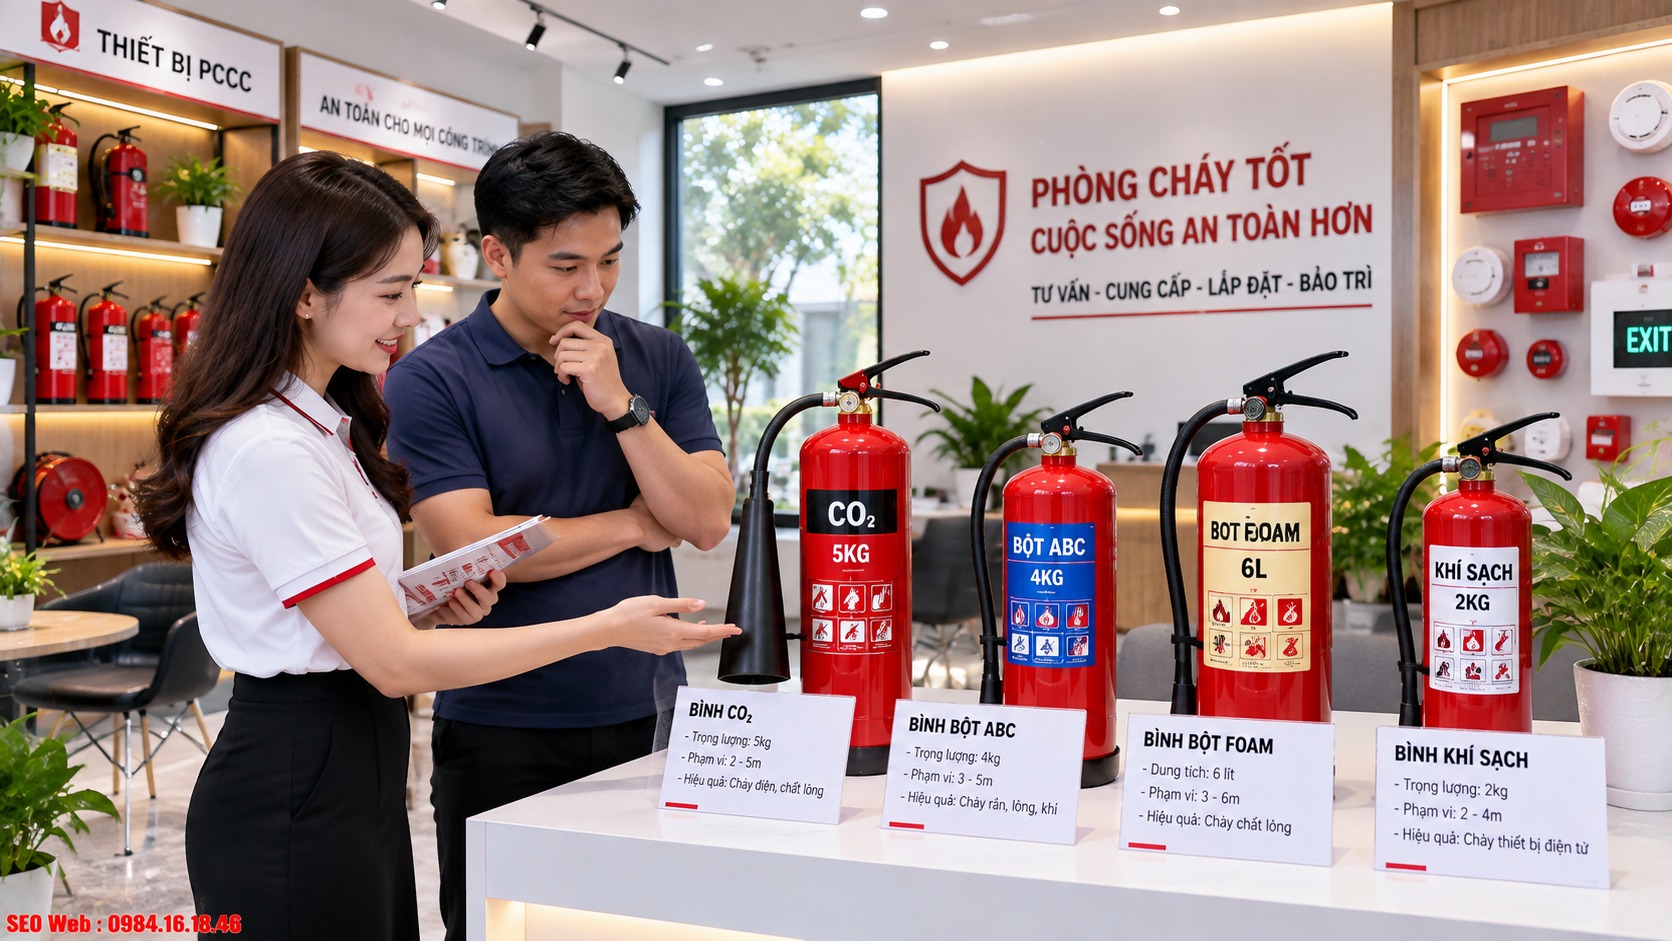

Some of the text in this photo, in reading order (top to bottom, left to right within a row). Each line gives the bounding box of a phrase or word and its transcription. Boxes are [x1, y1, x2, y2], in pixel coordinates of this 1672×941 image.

[96, 28, 252, 92] THIẾT BỊ PCCC
[319, 95, 341, 117] AN
[383, 113, 410, 135] CHO
[413, 122, 435, 146] MỌI
[1031, 141, 1312, 208] PHÒNG CHÁY TỐT
[1031, 201, 1373, 260] CUỘC SỐNG AN TOÀN HƠN
[1031, 284, 1053, 304] TƯ
[1057, 277, 1090, 303] VẤN
[1105, 281, 1152, 301] CUNG
[1157, 272, 1192, 298] CẤP
[1246, 271, 1282, 299] ĐẶT
[1299, 266, 1338, 292] BẢO
[1342, 264, 1373, 290] TRÌ
[1626, 325, 1672, 353] EXIT
[832, 543, 870, 564] 5KG
[1013, 533, 1086, 559] BỘT ABC
[1030, 568, 1064, 586] 4KG
[1241, 557, 1268, 579] 6L
[1435, 558, 1513, 586] KHÍ SẠCH
[1455, 593, 1490, 611] 2KG
[689, 699, 724, 719] BÌNH
[908, 713, 1016, 739] BÌNH BỘT ABC
[691, 730, 719, 746] Trọng
[721, 733, 751, 749] lượng:
[753, 735, 772, 751] 5kg
[1143, 727, 1274, 755] BÌNH BỘT FOAM
[687, 751, 715, 766] Phạm
[717, 754, 728, 767] vi:
[729, 755, 736, 767] 2
[745, 757, 762, 769] 5m
[914, 746, 943, 763] Trọng
[946, 749, 978, 765] lượng:
[981, 751, 1001, 767] 4kg
[1395, 741, 1529, 772] BÌNH KHÍ SẠCH
[683, 773, 705, 788] Hiệu
[910, 768, 940, 784] Phạm
[943, 771, 954, 784] vi:
[957, 772, 965, 785] 3
[975, 774, 993, 787] 5m
[1150, 763, 1181, 780] Dung
[1213, 767, 1220, 780] 6
[907, 791, 931, 807] Hiệu
[1149, 786, 1181, 802] Phạm
[1184, 789, 1198, 802] vi:
[1201, 790, 1209, 803] 3
[1221, 791, 1240, 805] 6m
[1403, 778, 1438, 796] Trọng
[1442, 780, 1481, 798] lượng:
[1485, 783, 1508, 800] 2kg
[1147, 810, 1173, 826] Hiệu
[1403, 802, 1438, 819] Phạm
[1442, 805, 1456, 819] vi:
[1460, 807, 1468, 820] 2
[1481, 808, 1503, 822] 4m
[1402, 827, 1430, 845] Hiệu
[1529, 837, 1541, 854] bị
[1544, 838, 1572, 856] điện
